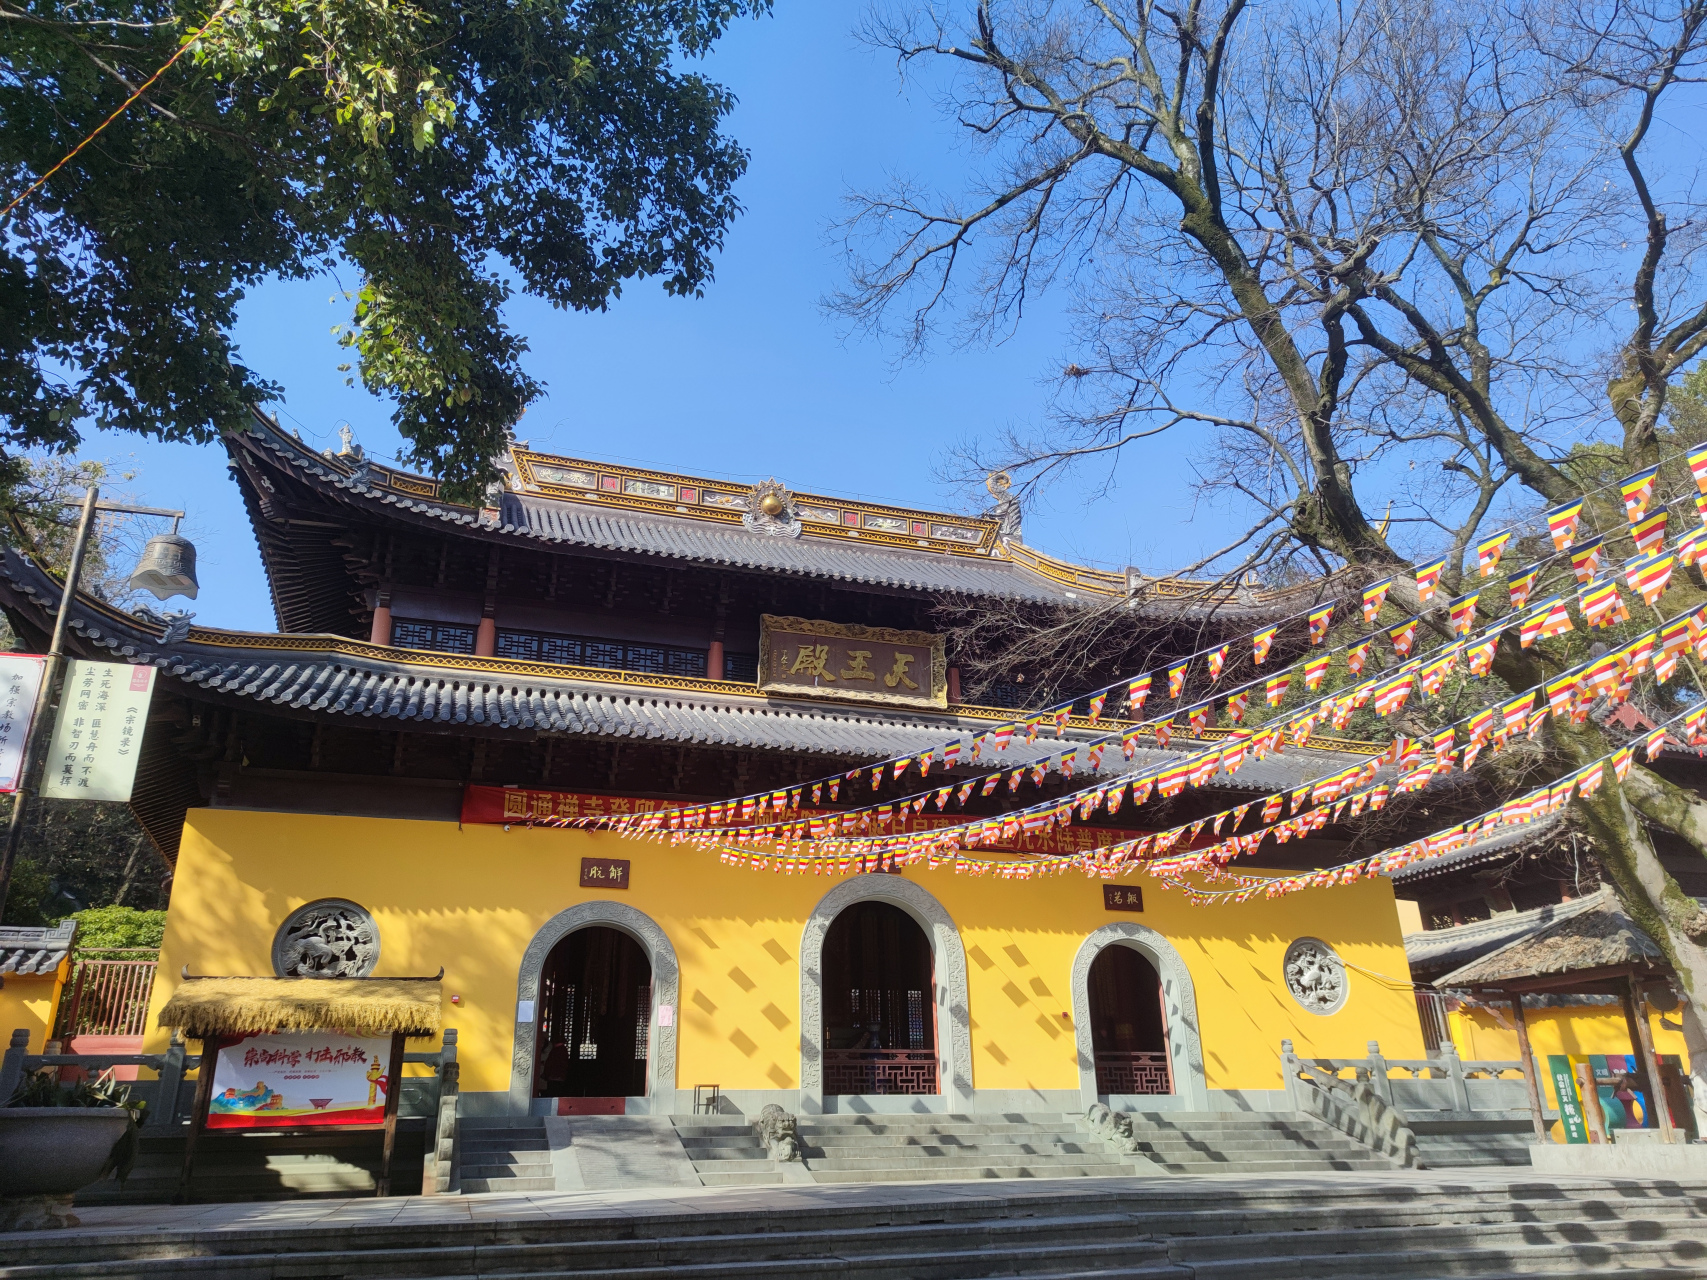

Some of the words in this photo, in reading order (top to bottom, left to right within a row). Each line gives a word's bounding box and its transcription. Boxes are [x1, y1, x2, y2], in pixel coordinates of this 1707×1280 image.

[77, 666, 96, 711] 尘劳网密
[95, 668, 113, 712] 生死海深
[790, 643, 919, 690] 天王殿
[0, 673, 23, 766] 加强宗教场所
[118, 706, 138, 756] 《宗镜录》
[59, 717, 85, 787] 非智刃而莫挥
[244, 1047, 302, 1068] 崇尚科学
[305, 1046, 367, 1067] 打击邪教
